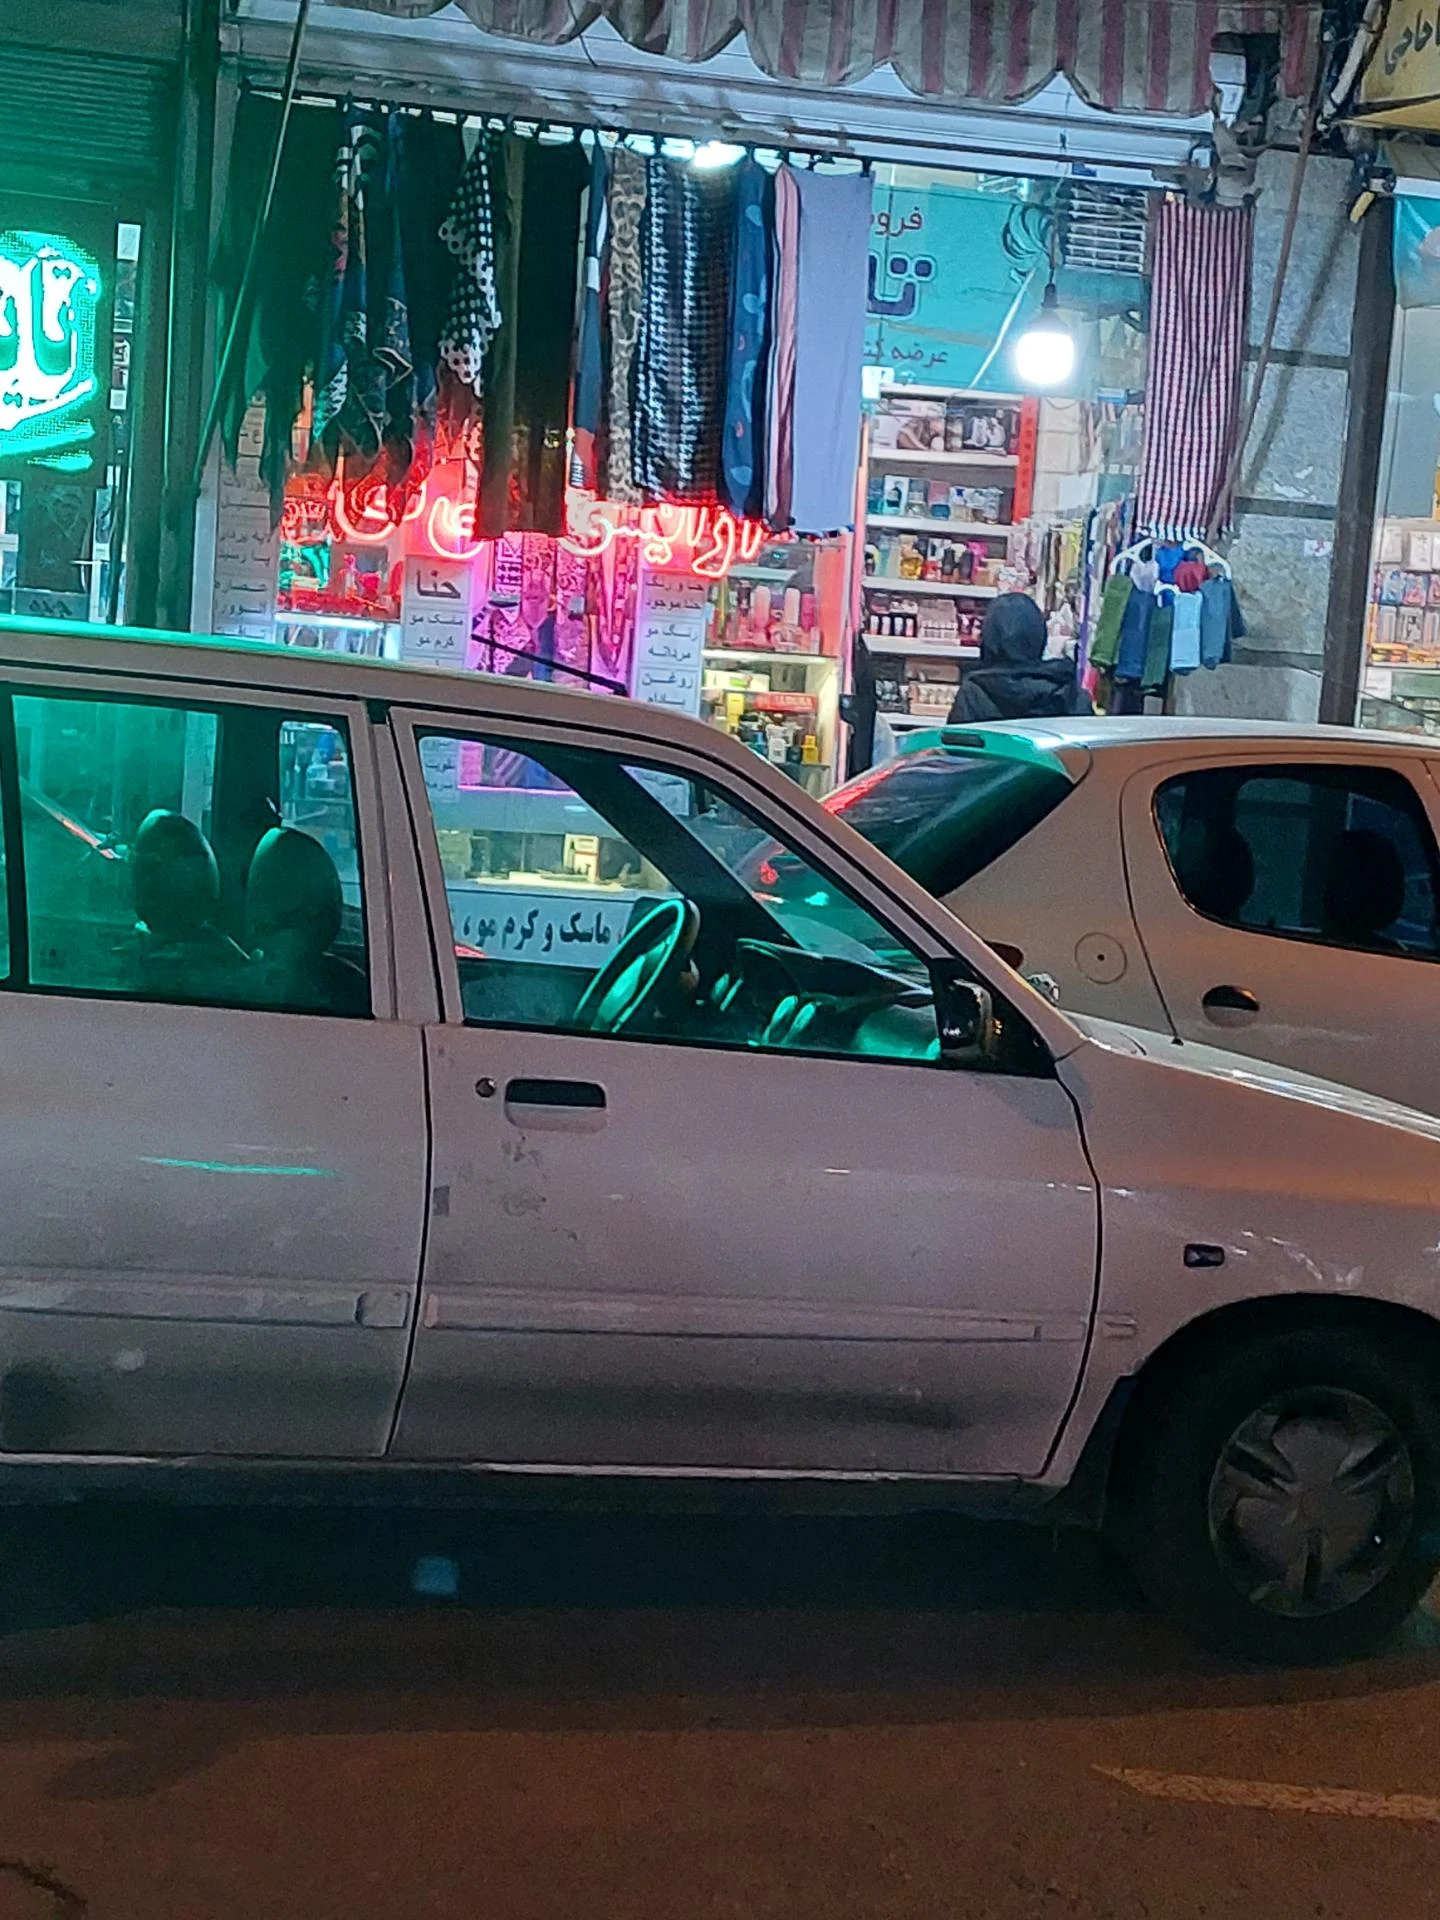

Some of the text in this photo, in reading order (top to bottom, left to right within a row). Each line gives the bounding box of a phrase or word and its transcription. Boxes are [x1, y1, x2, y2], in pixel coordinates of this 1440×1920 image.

[891, 342, 949, 369] عرضه
[416, 569, 461, 599] حنا
[647, 645, 692, 662] مردانه
[641, 671, 693, 690] روغن
[500, 908, 540, 951] کرم
[542, 922, 554, 952] و
[559, 911, 612, 945] ماسک
